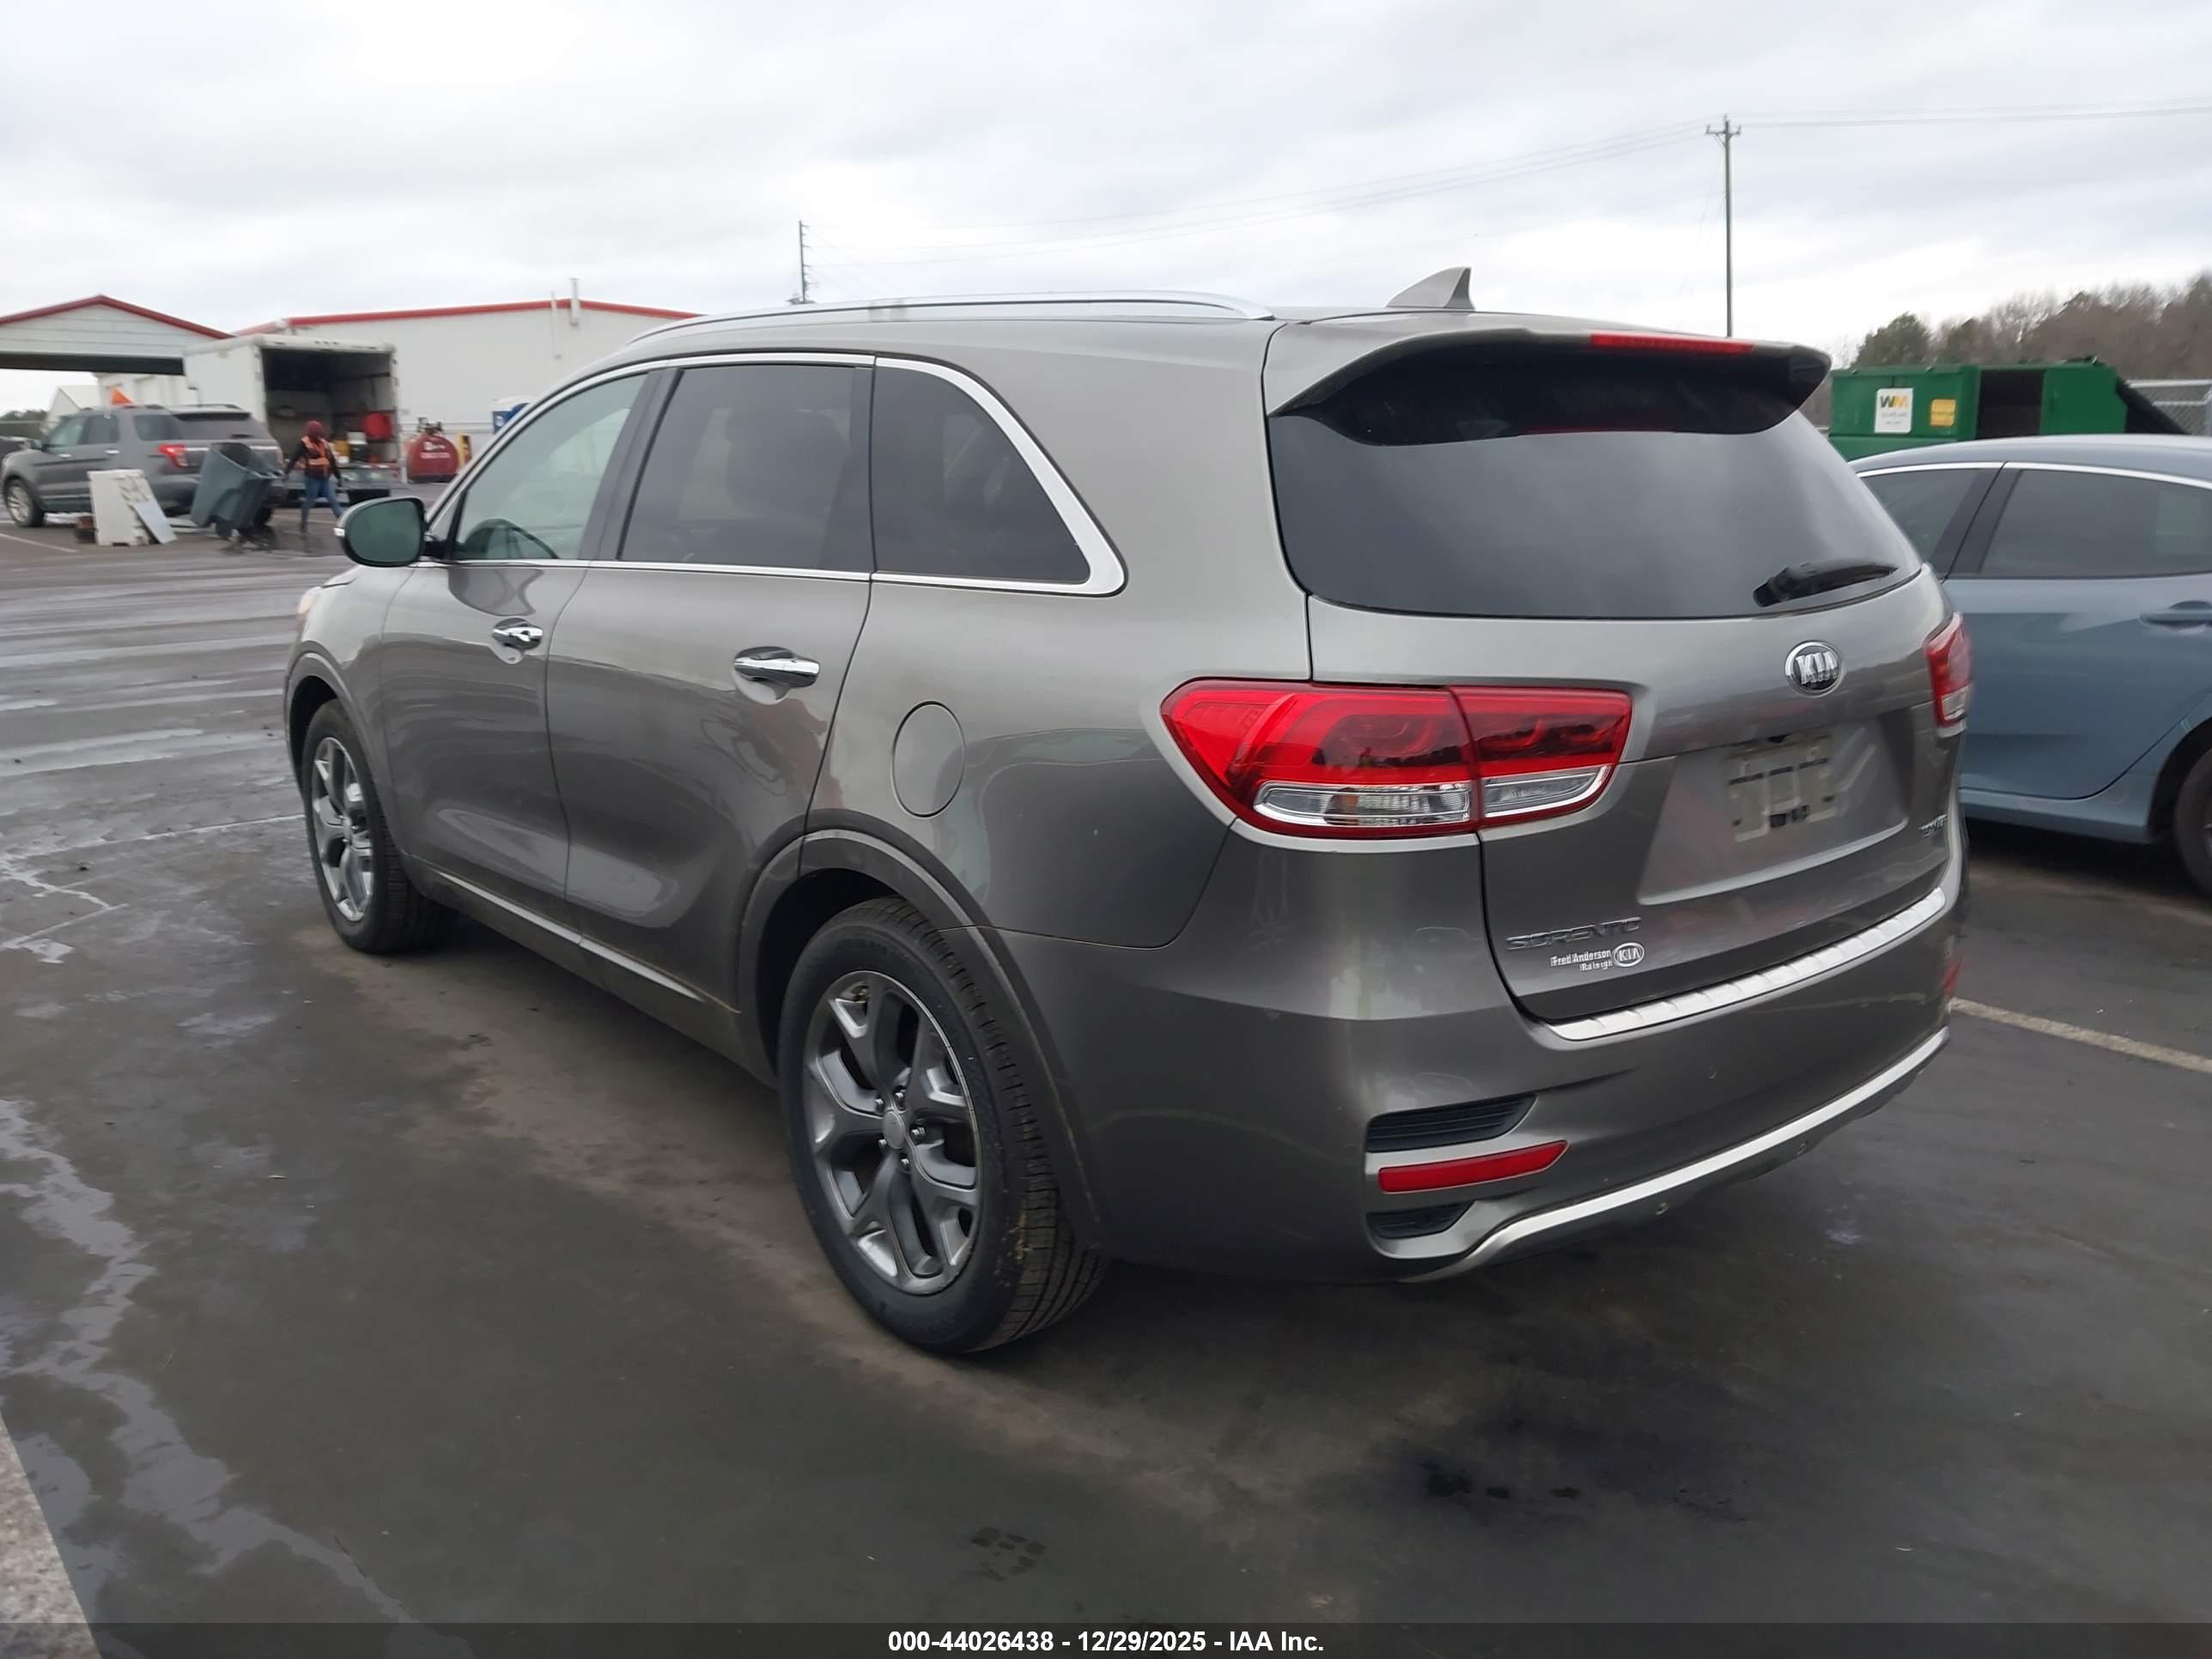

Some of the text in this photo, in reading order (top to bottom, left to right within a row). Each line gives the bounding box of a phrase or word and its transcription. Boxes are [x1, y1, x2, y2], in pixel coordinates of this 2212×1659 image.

[1880, 395, 1908, 408] WM
[1796, 650, 1838, 684] KIA
[1550, 949, 1612, 966] Fred Anderson
[1618, 947, 1641, 962] KIA
[1579, 960, 1613, 971] Raleigh
